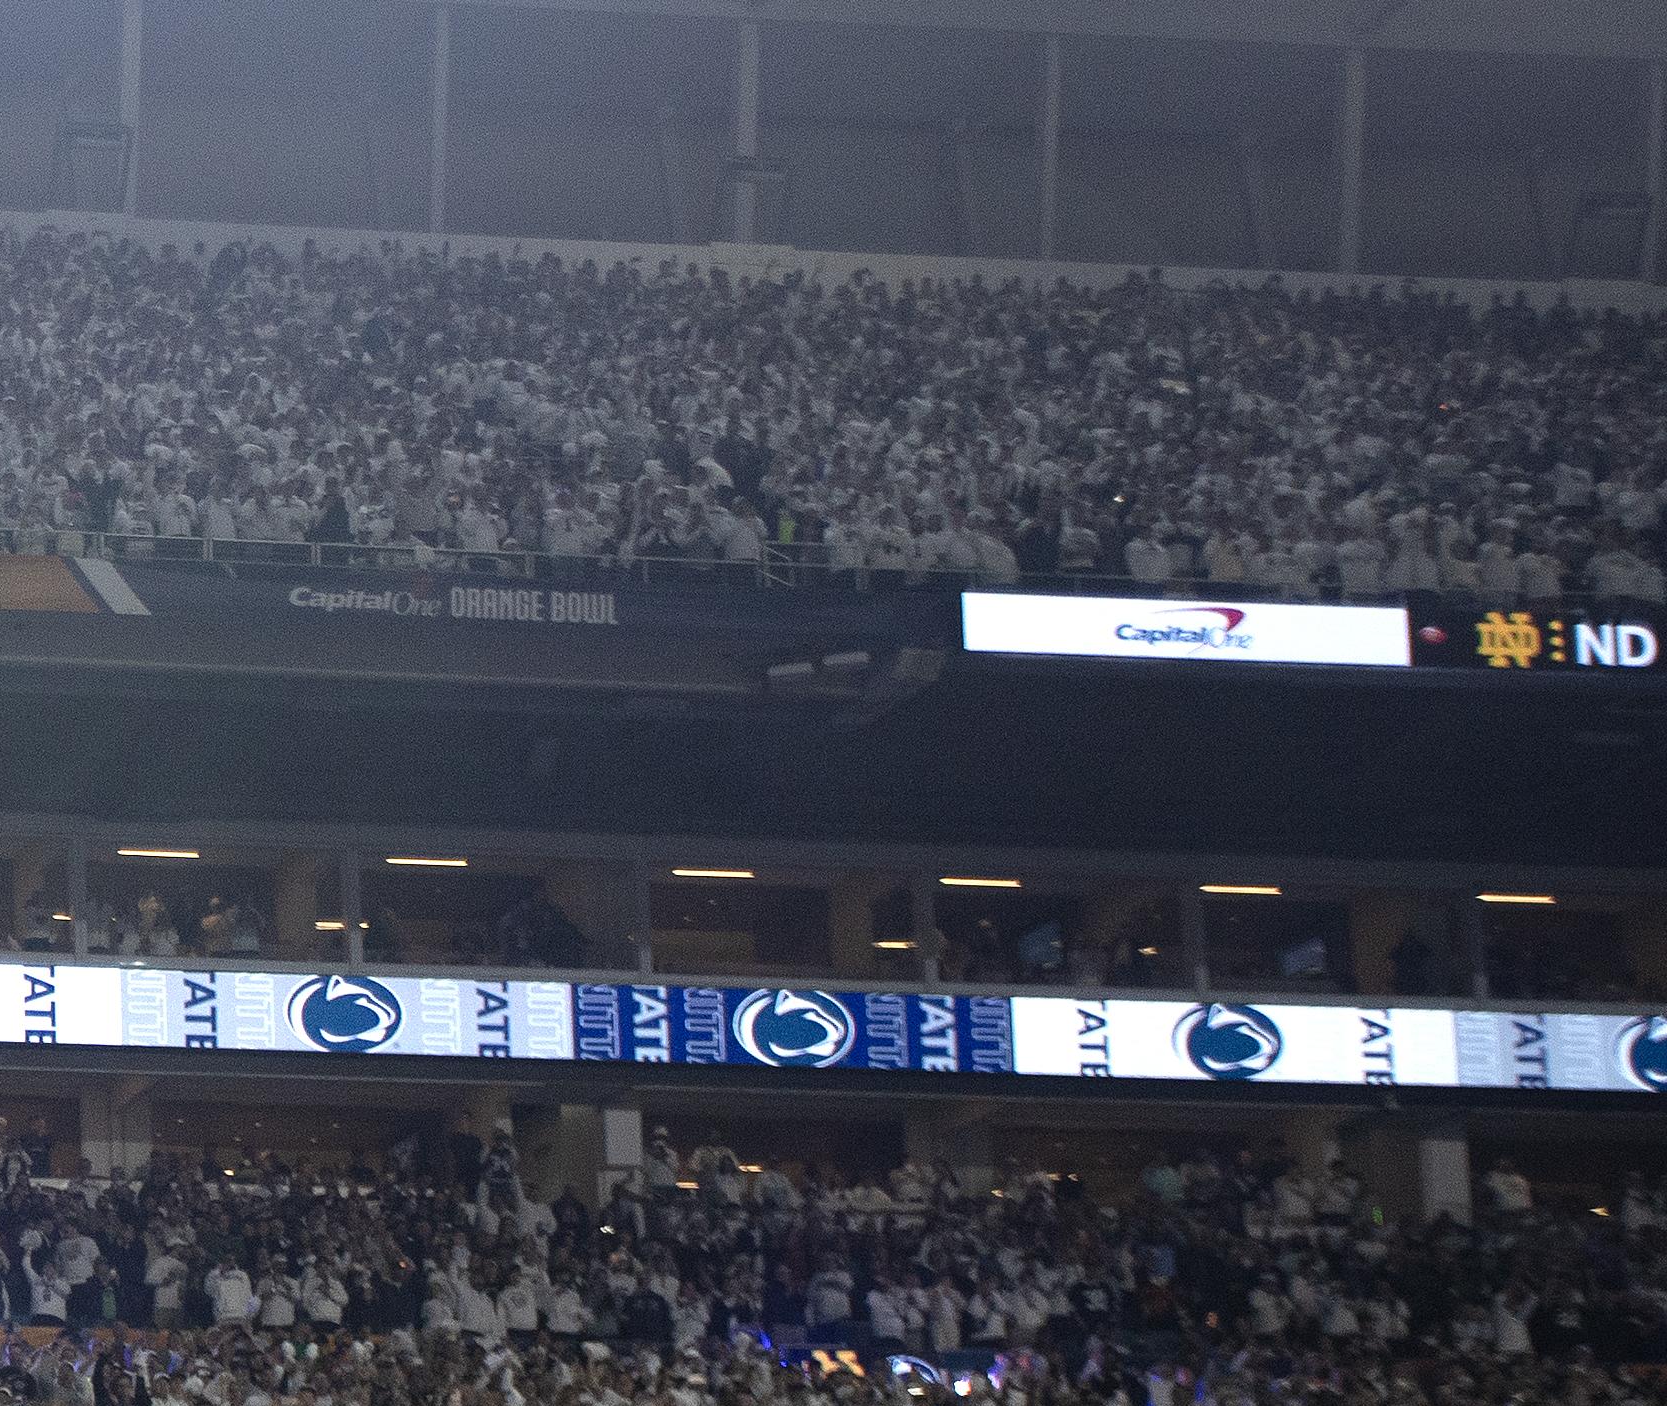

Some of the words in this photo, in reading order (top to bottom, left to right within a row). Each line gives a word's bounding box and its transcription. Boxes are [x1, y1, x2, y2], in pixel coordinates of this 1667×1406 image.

[450, 586, 544, 622] ORANGE
[551, 591, 618, 626] BOWL
[1574, 624, 1658, 668] ND
